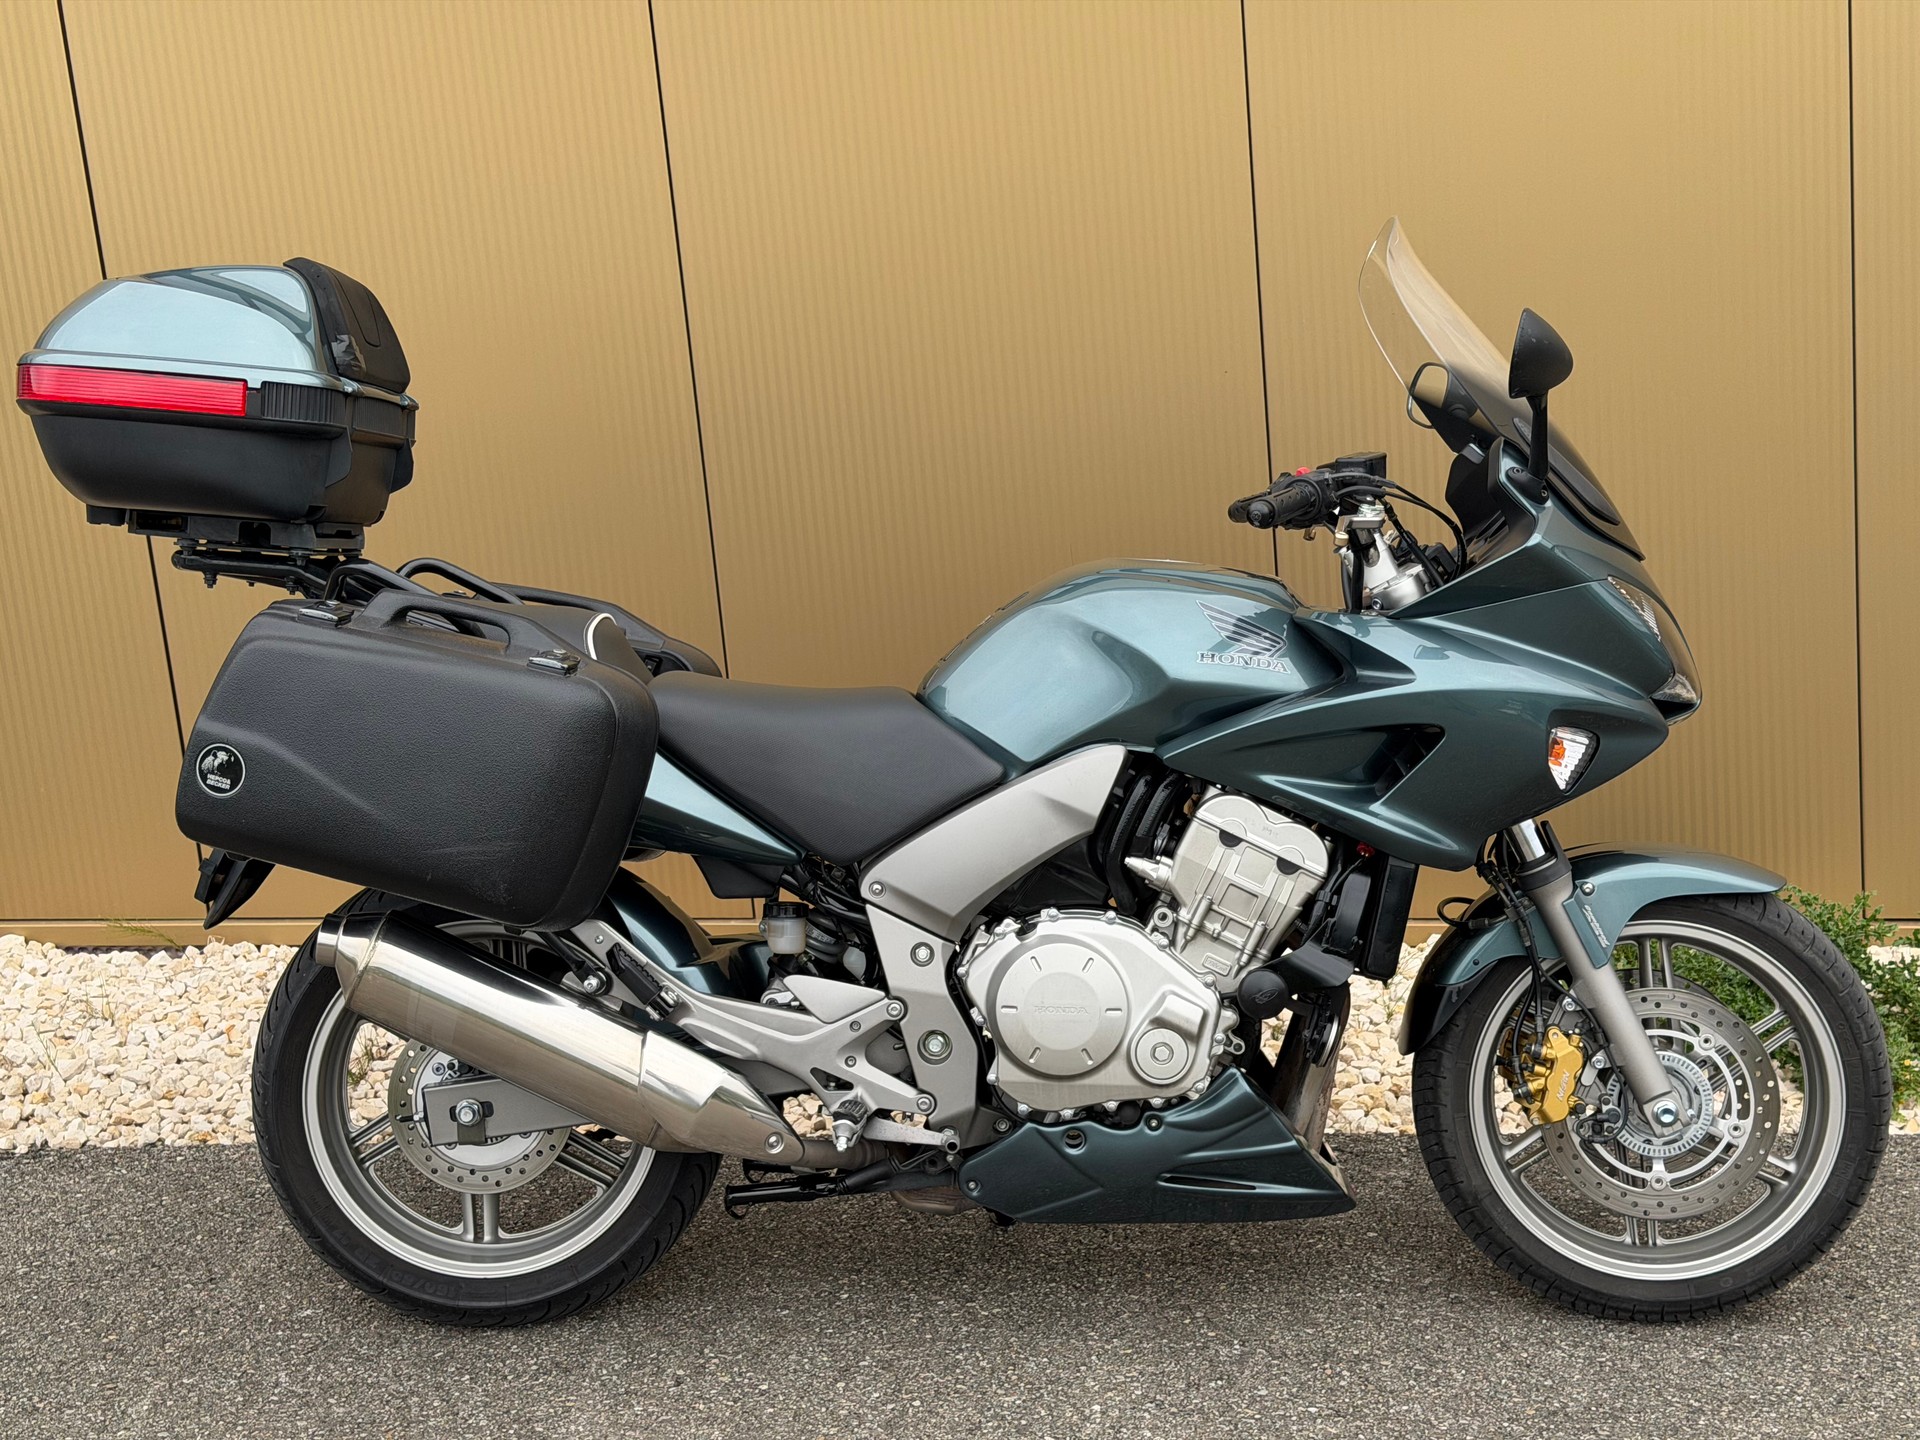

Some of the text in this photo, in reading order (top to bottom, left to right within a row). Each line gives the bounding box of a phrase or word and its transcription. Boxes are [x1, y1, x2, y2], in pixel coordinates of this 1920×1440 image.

[1197, 651, 1290, 674] HONDA
[206, 779, 230, 790] BECKER
[1033, 1004, 1089, 1015] HONDA
